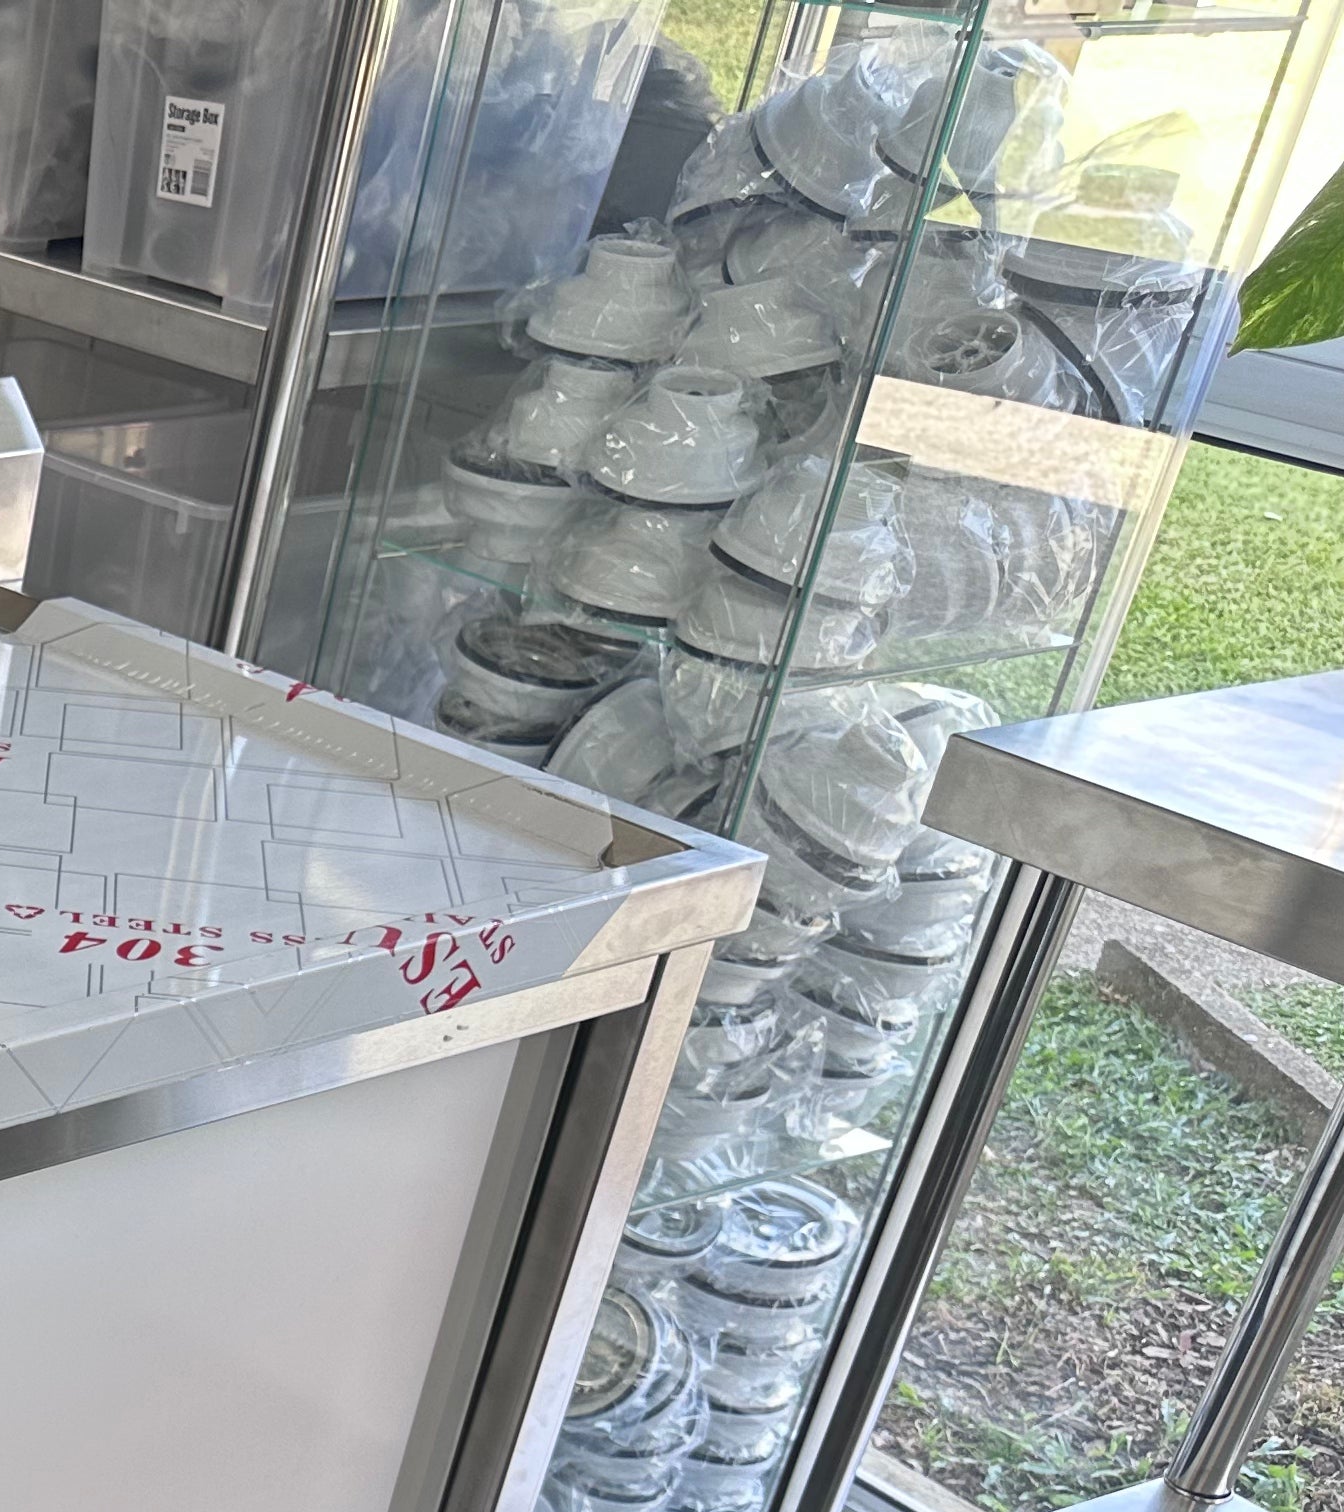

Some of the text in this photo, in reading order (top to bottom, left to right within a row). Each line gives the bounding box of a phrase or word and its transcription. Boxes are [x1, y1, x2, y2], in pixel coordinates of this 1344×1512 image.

[168, 102, 220, 126] Storage Box
[60, 910, 223, 939] STEEL
[59, 931, 224, 967] 304
